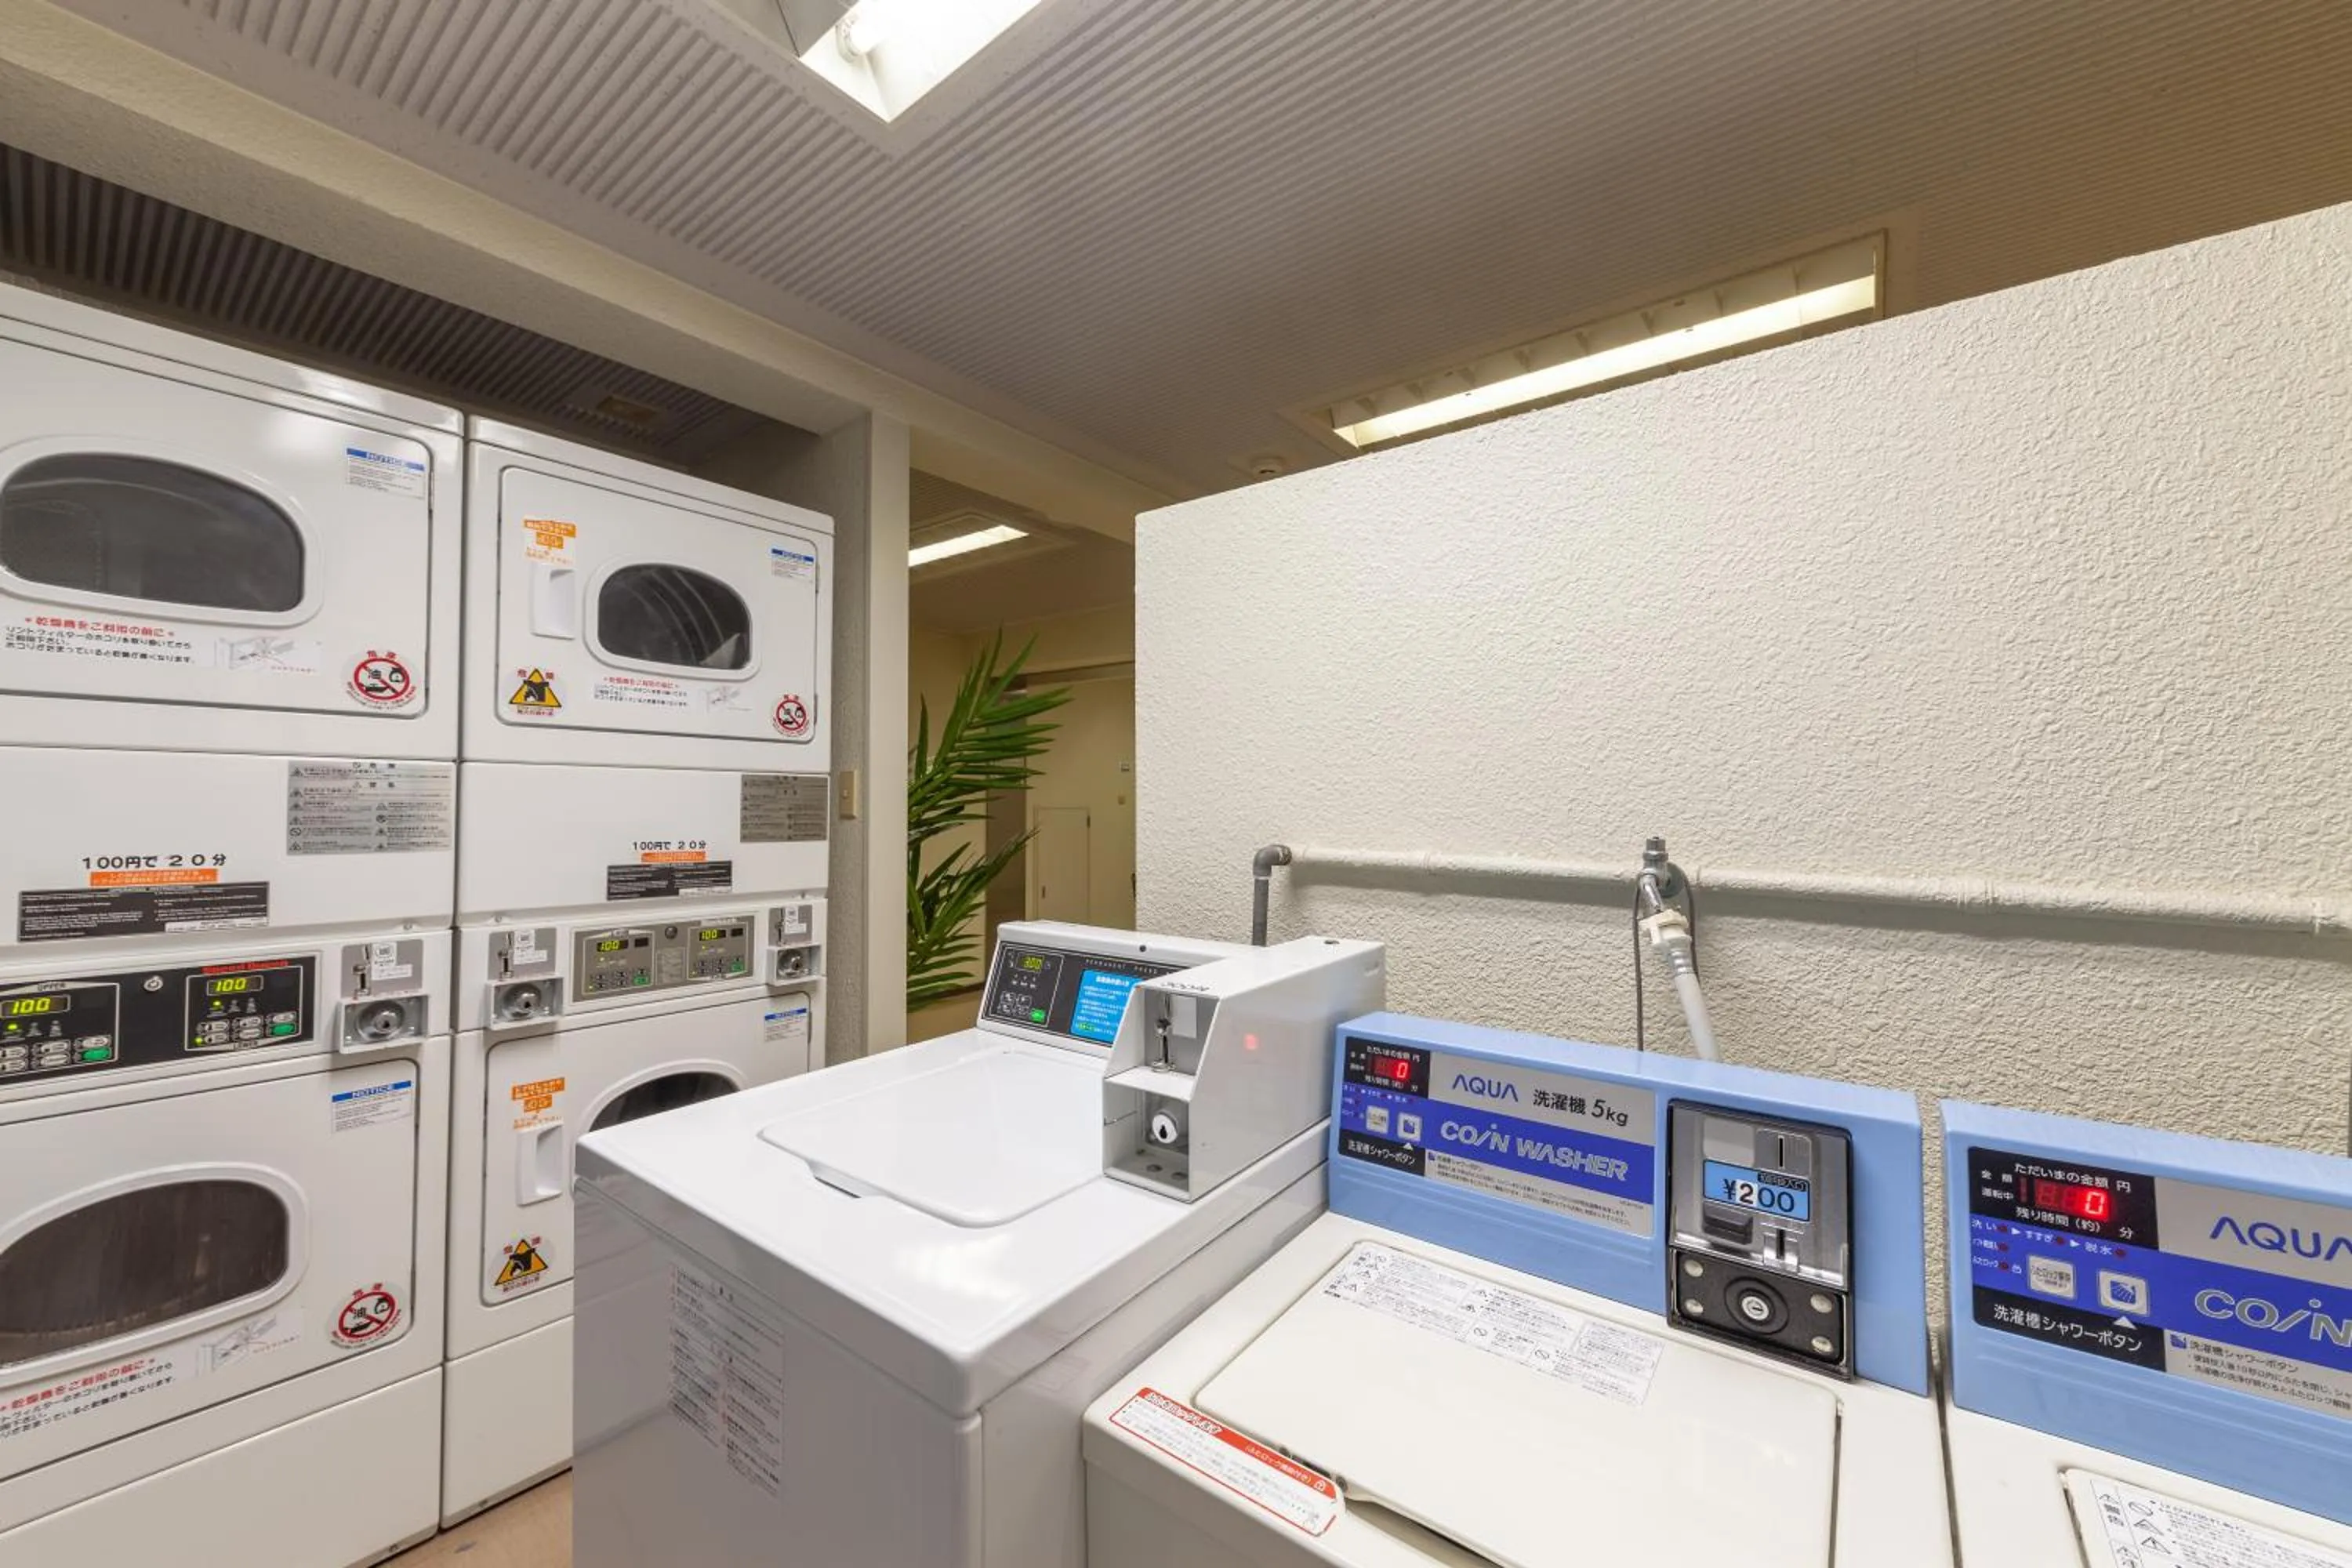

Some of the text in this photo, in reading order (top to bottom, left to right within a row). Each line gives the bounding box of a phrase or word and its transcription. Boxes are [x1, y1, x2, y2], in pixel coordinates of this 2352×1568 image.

[216, 978, 247, 992] 100
[12, 997, 51, 1014] 100
[1396, 1062, 1409, 1078] 0
[1452, 1073, 1519, 1102] AQUA
[1533, 1089, 1629, 1127] 洗濯機 5kg
[1516, 1137, 1629, 1181] WASHER
[2014, 1163, 2131, 1193] ただいまの金額 円
[1723, 1178, 1795, 1213] ¥200
[2085, 1191, 2105, 1215] 0
[2119, 1226, 2134, 1240] 分
[2209, 1216, 2352, 1261] AQUA
[1993, 1303, 2143, 1352] 洗濯槽シャワーボタン
